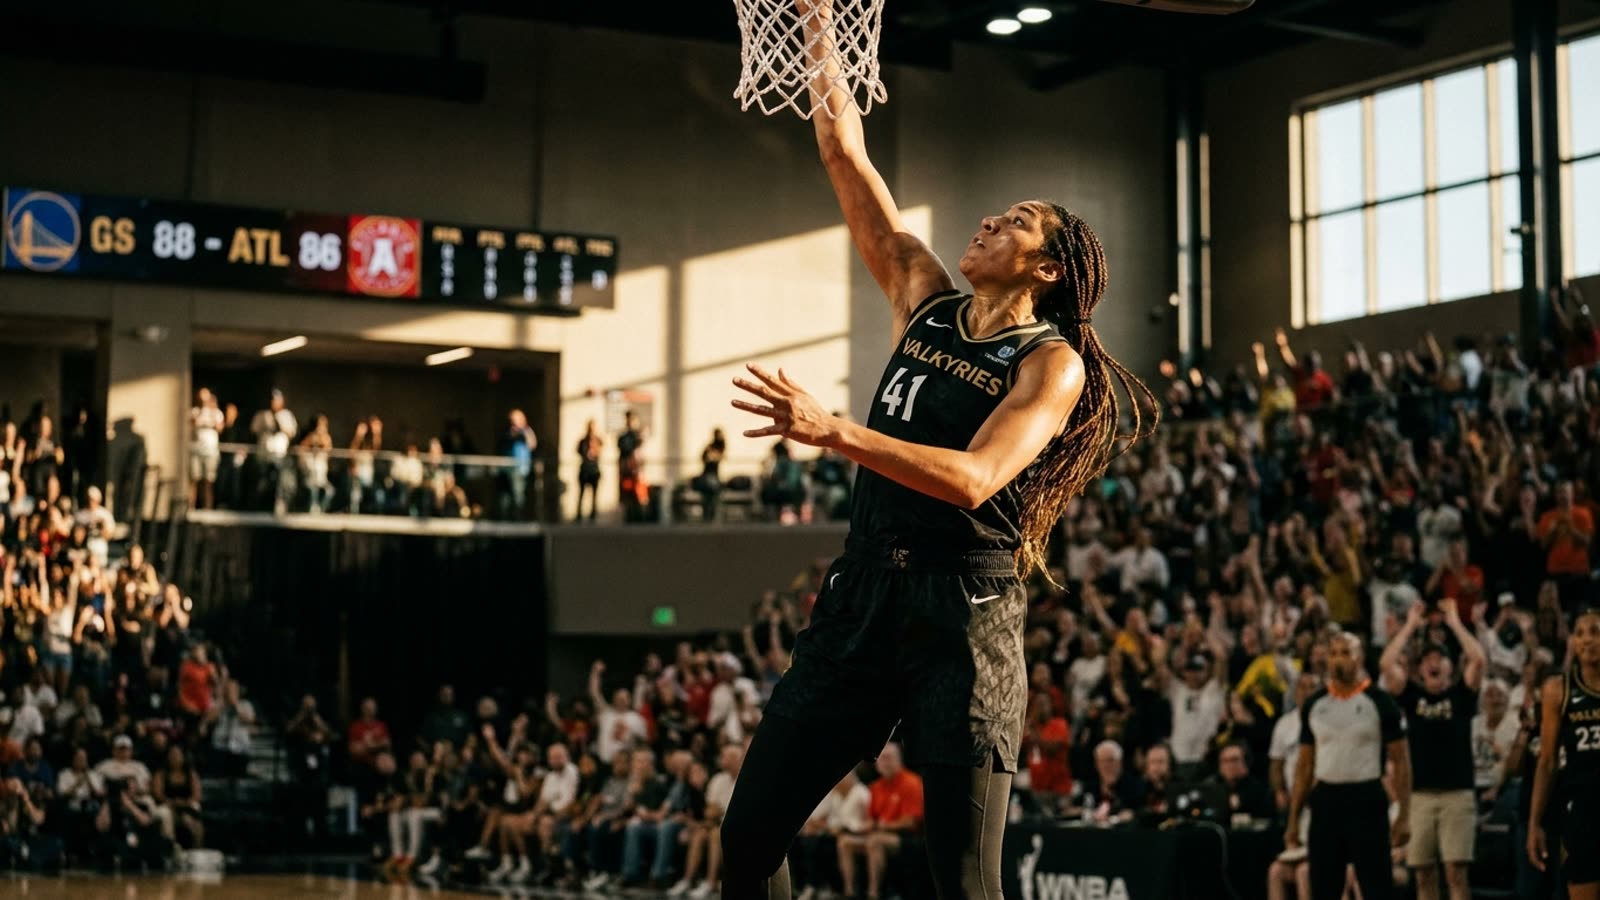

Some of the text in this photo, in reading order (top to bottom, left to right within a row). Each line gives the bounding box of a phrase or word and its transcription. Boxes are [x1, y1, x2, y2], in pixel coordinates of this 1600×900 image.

[90, 215, 136, 255] GS
[152, 220, 196, 260] 88
[228, 227, 290, 267] ATL
[299, 231, 341, 271] 86
[881, 366, 928, 422] 41
[902, 337, 1003, 396] VALKYRIES
[1036, 871, 1131, 900] WNBA
